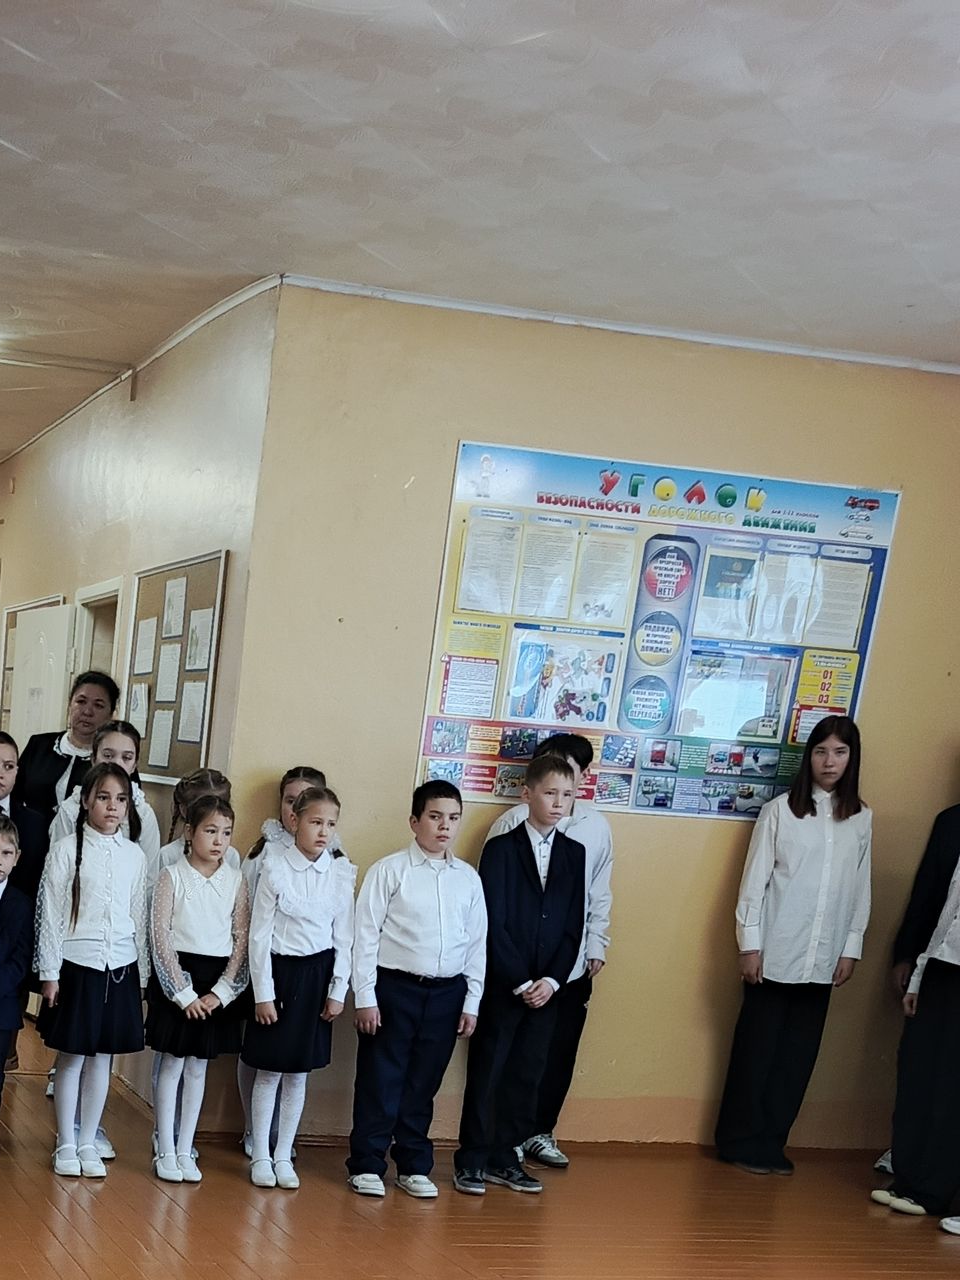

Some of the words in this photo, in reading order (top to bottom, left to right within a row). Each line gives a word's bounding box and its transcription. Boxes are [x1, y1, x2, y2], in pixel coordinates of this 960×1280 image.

[599, 468, 768, 512] УГОЛОК
[536, 491, 641, 514] БЕЗОПАСНОСТИ
[648, 503, 736, 525] ДОРОЖНОГО
[742, 514, 816, 534] ДВИЖЕНИЯ
[657, 587, 674, 597] НЕТ!
[822, 669, 833, 679] 01
[820, 681, 832, 691] 02
[818, 694, 829, 704] 03
